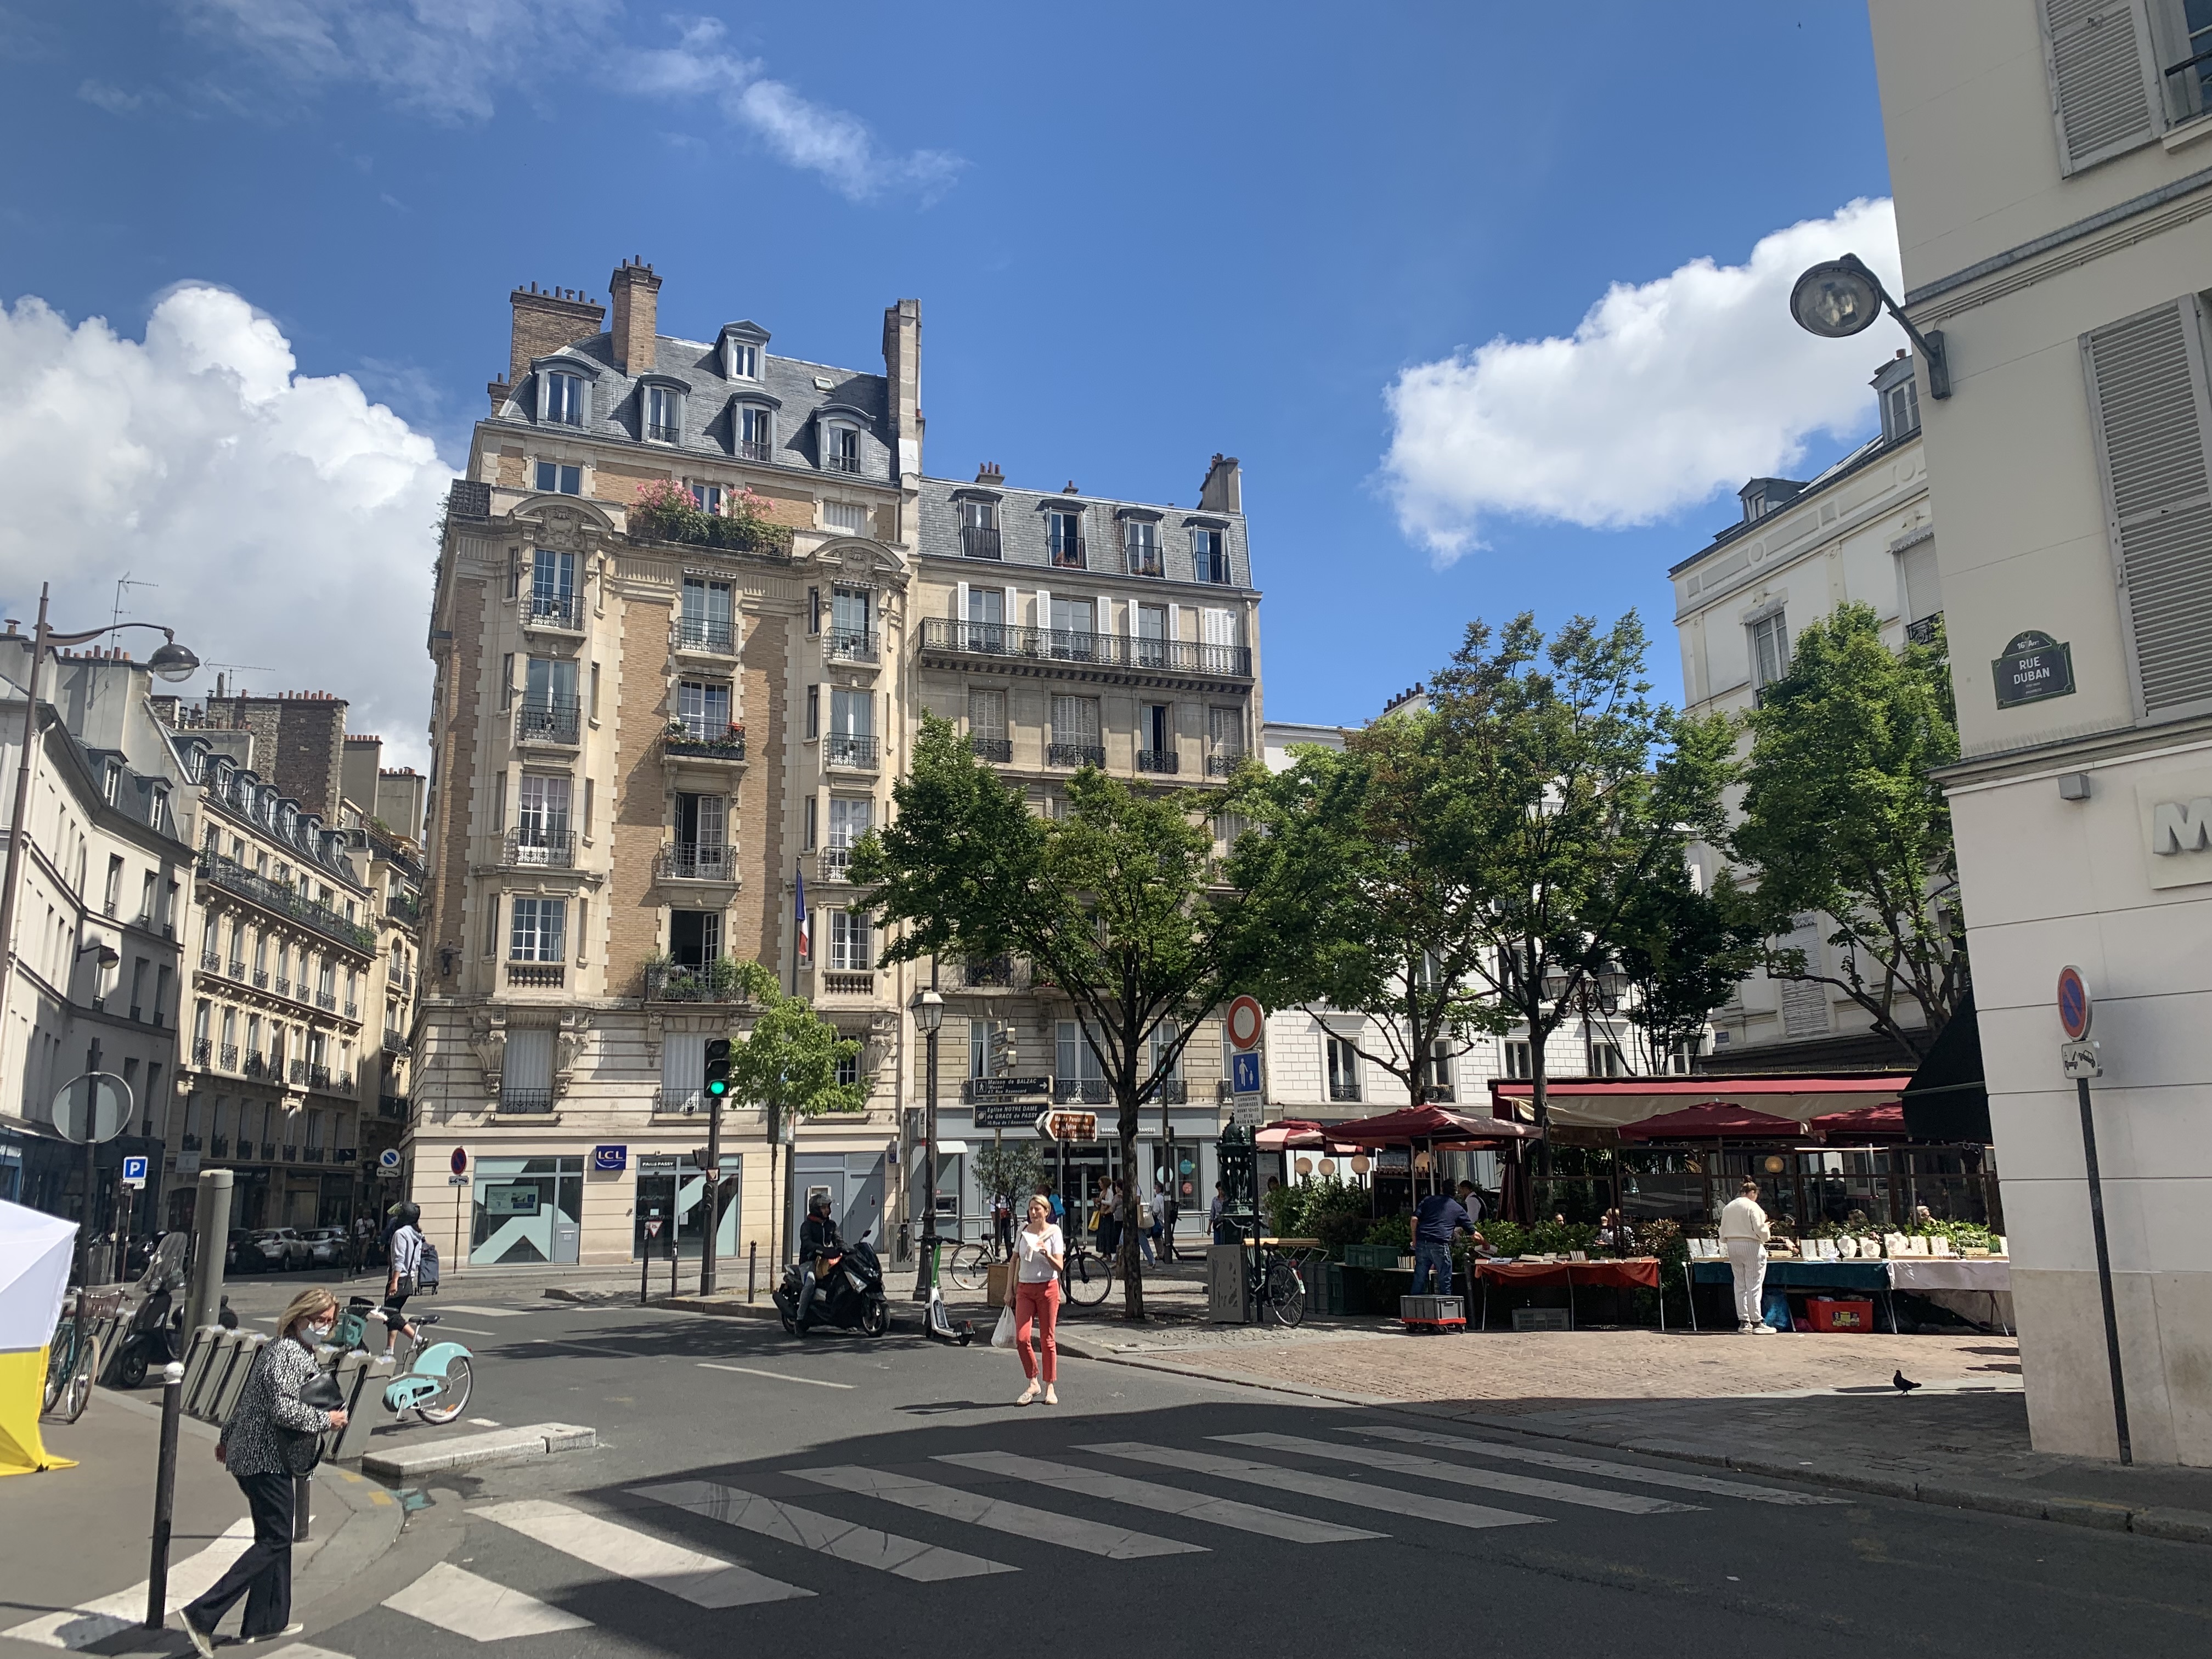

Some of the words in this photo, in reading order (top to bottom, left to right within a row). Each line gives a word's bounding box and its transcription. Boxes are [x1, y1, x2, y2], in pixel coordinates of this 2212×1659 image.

[2019, 656, 2041, 670] RUE
[2013, 667, 2050, 685] DUBAN
[598, 1150, 623, 1159] LCL
[130, 1162, 140, 1175] P
